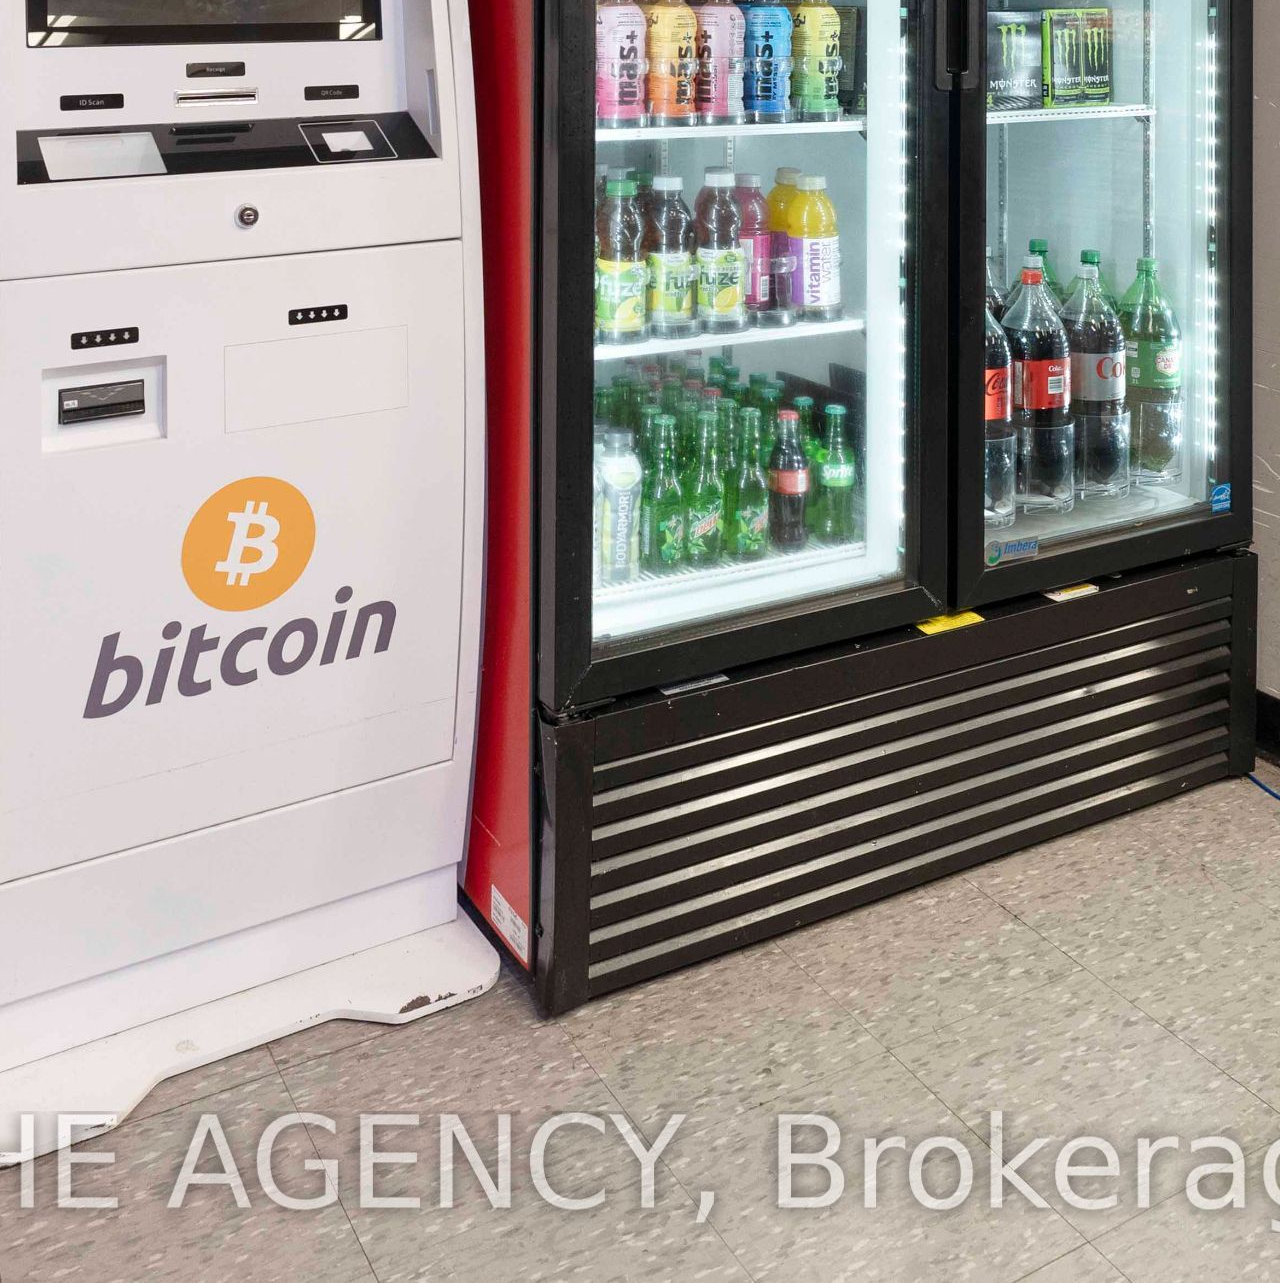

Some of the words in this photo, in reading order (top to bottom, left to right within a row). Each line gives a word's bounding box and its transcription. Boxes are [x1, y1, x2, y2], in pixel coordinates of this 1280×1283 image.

[989, 77, 1037, 91] MONSTER
[79, 98, 87, 106] ID
[87, 98, 105, 107] Scan
[806, 241, 821, 304] vitamin
[821, 242, 832, 284] water
[599, 274, 642, 296] fuze
[665, 271, 692, 290] fuz
[699, 265, 739, 286] fuze
[1096, 357, 1126, 381] Co
[822, 464, 854, 480] Sprite
[82, 585, 397, 720] bitcoin
